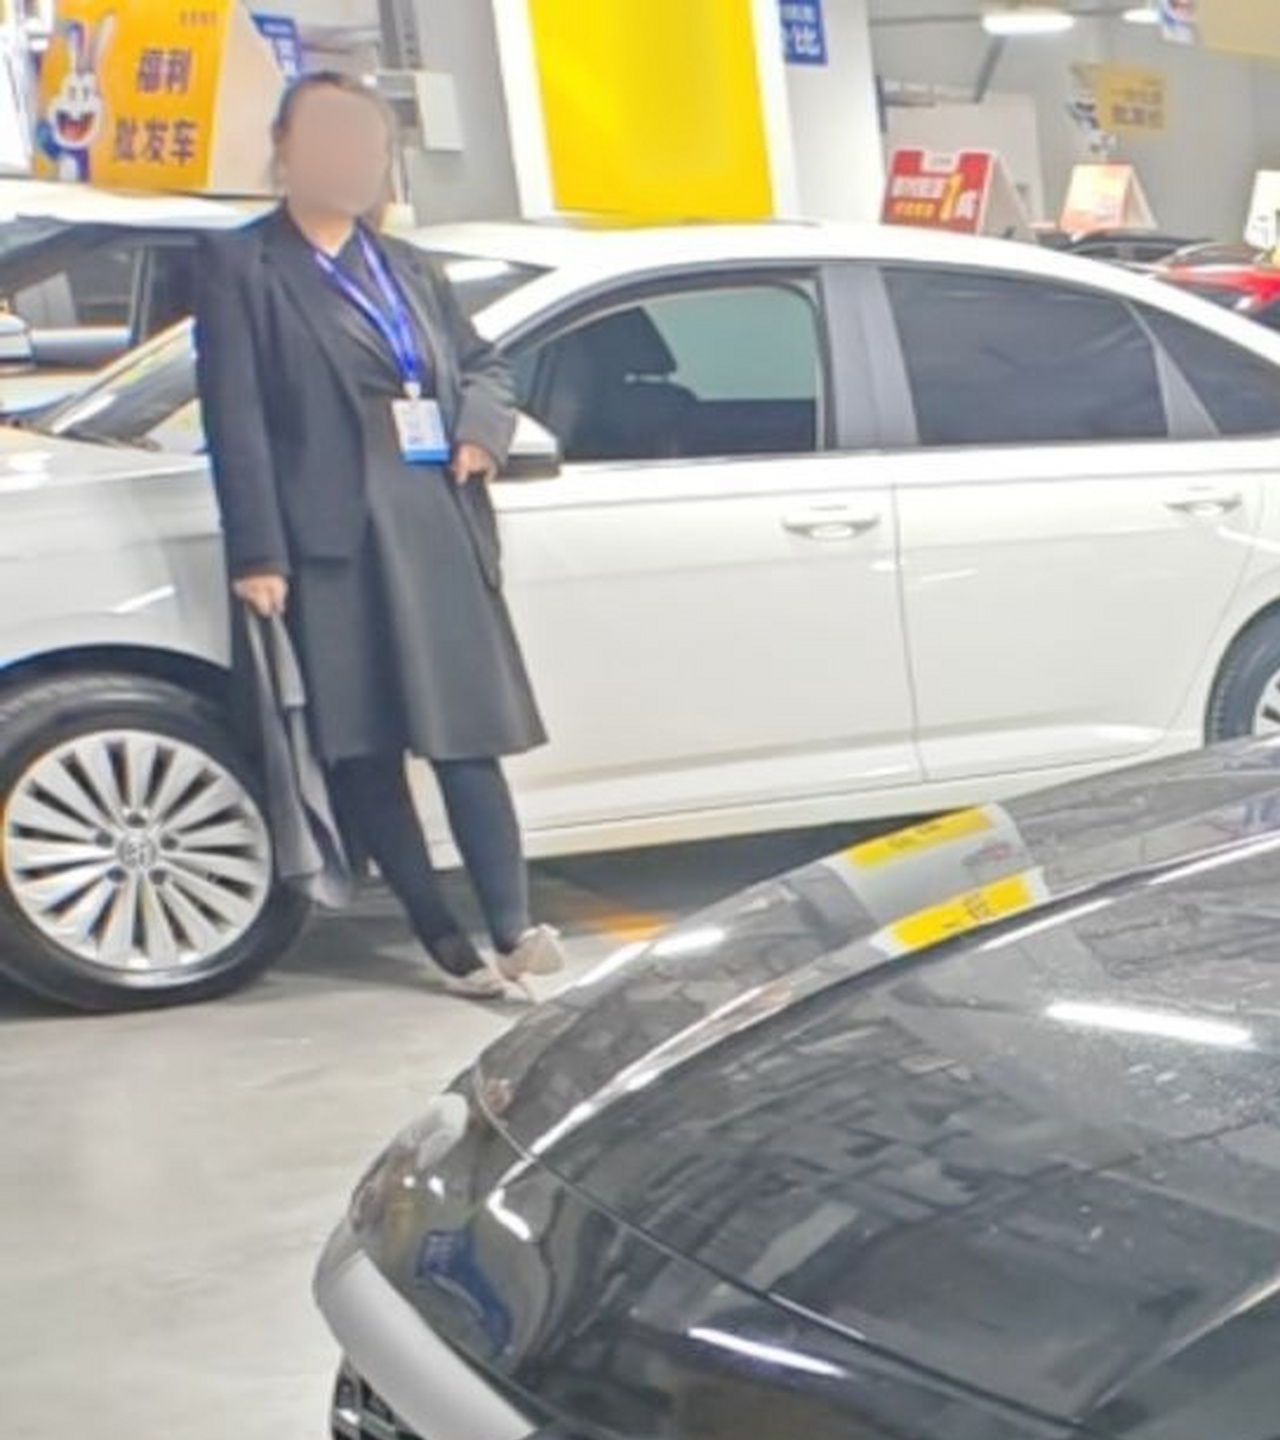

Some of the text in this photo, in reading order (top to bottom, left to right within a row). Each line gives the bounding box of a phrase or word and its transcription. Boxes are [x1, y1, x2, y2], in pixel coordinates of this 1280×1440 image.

[136, 48, 193, 93] 福利
[113, 117, 197, 166] 批发车
